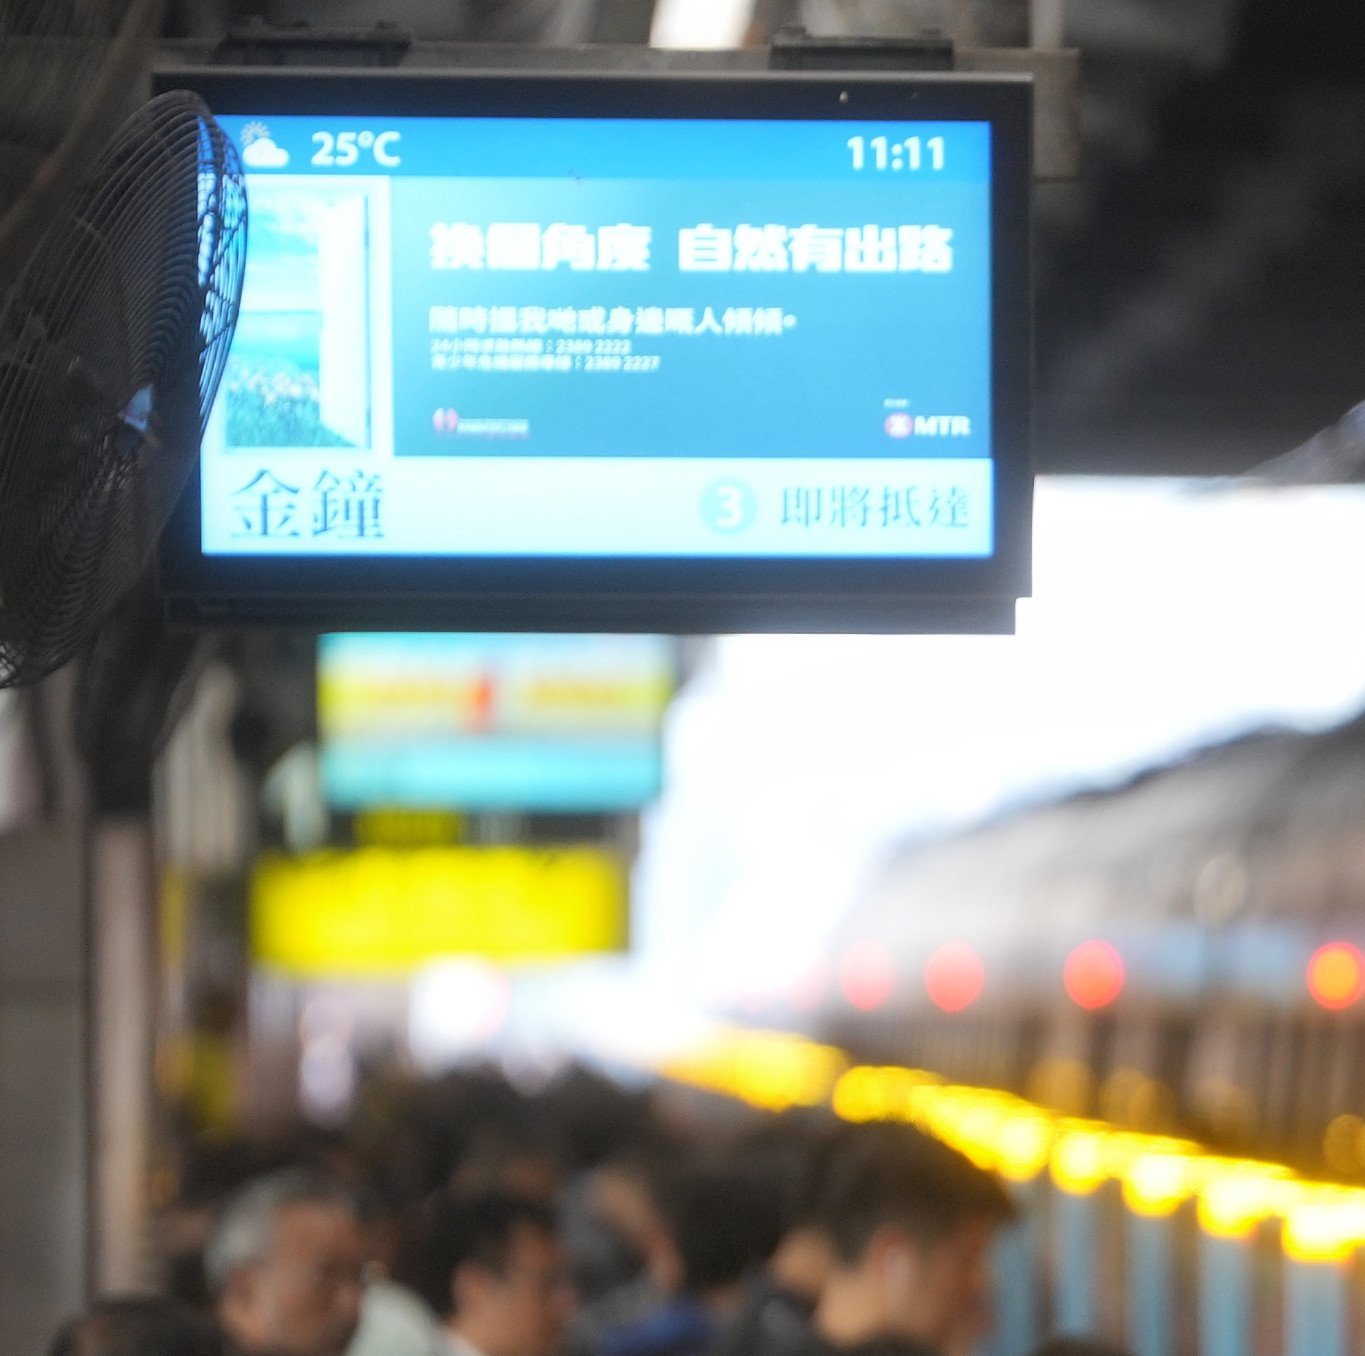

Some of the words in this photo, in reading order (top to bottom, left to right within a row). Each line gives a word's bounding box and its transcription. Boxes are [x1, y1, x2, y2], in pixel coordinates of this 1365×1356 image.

[311, 130, 402, 166] 25°C
[846, 135, 945, 170] 11:11
[678, 223, 954, 272] 自然有出路
[913, 414, 971, 437] MTR
[230, 467, 385, 539] 金鐘
[718, 484, 743, 520] 3
[780, 485, 971, 530] 即將抵達
